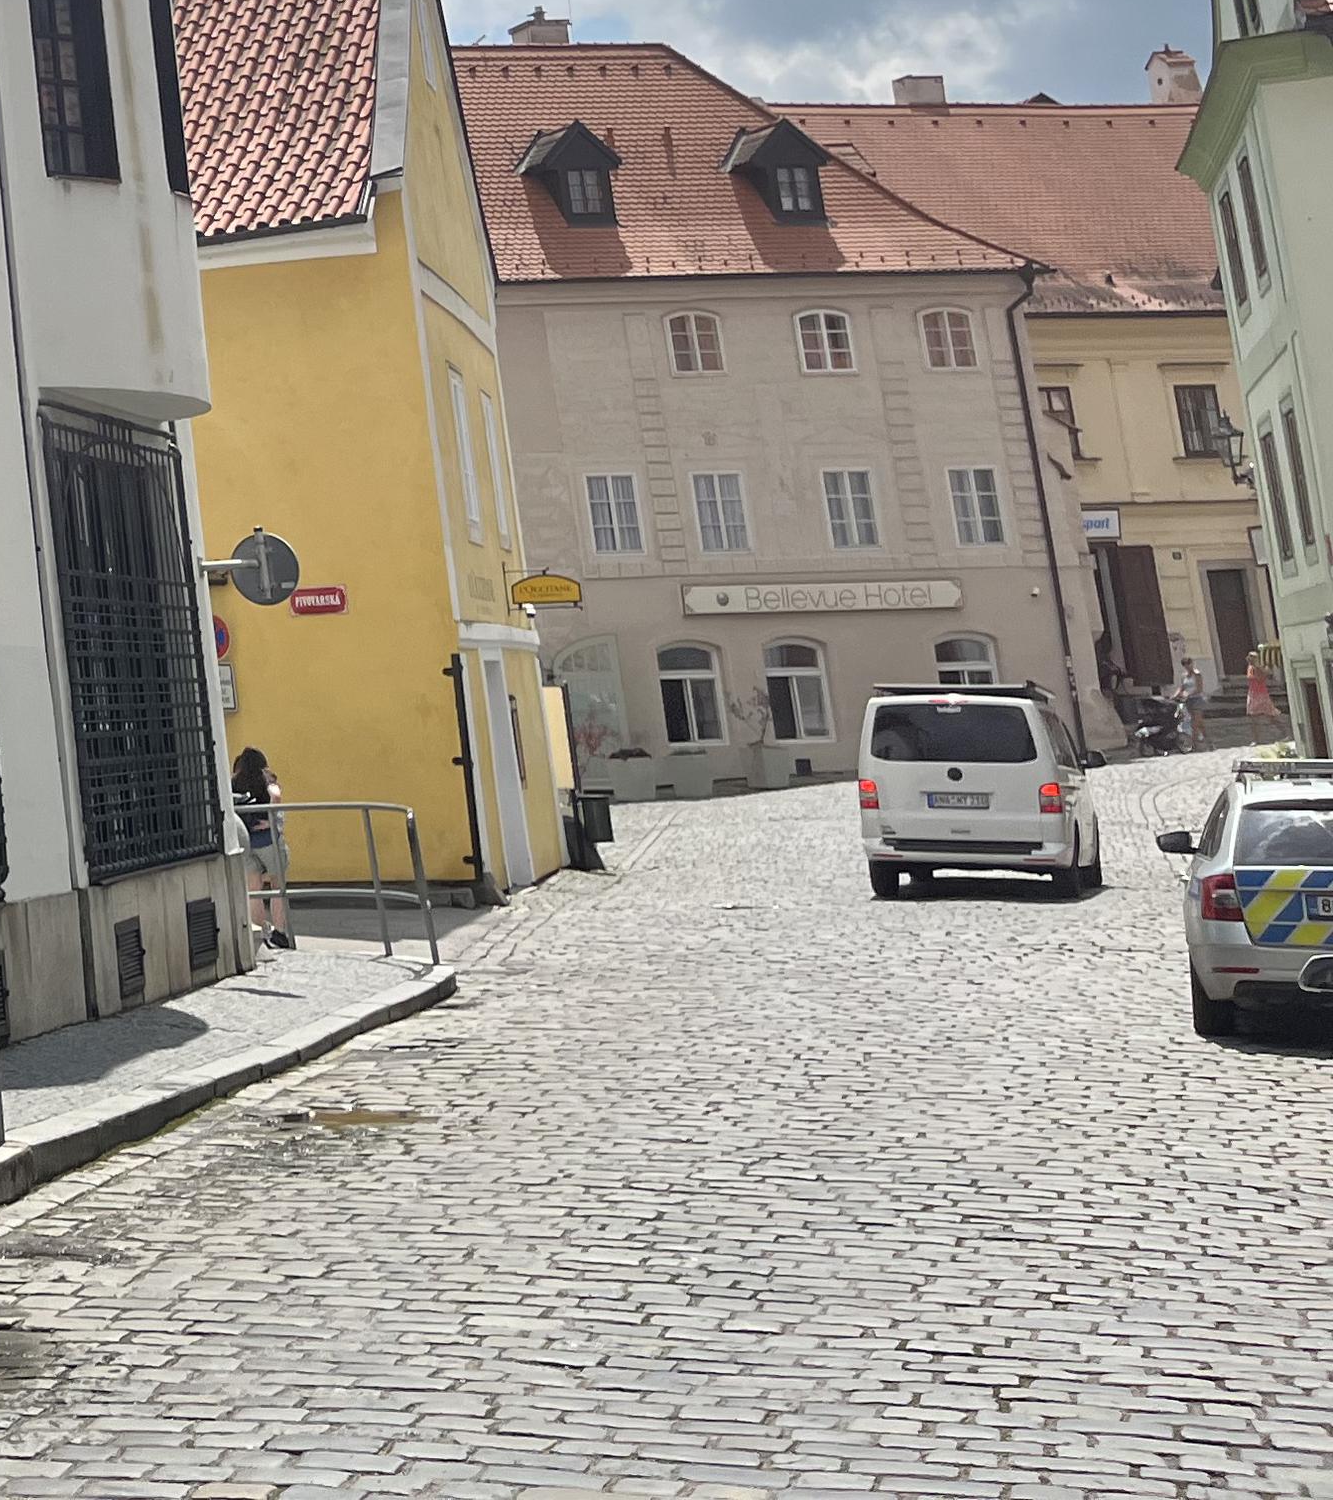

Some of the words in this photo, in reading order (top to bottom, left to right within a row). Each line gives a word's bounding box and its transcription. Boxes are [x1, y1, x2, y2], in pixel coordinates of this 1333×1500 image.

[295, 591, 341, 608] PIVOVARSKÁ
[744, 586, 856, 611] Bellevue
[864, 583, 933, 608] Hotel
